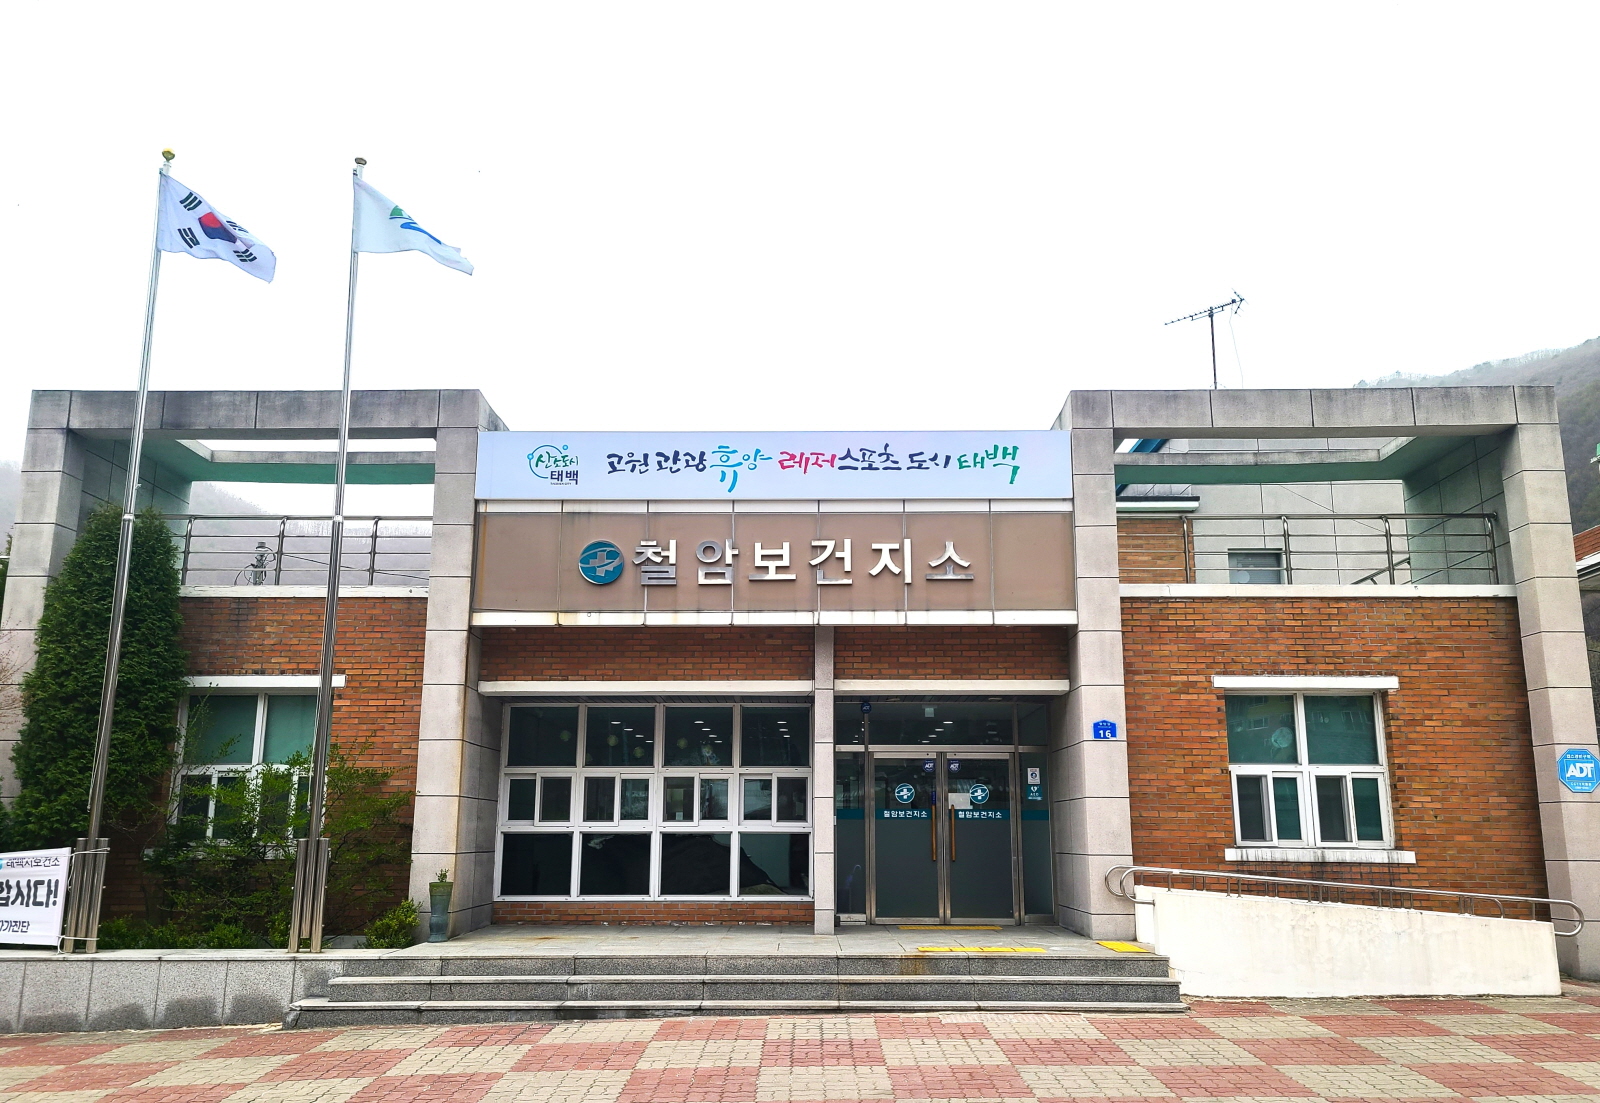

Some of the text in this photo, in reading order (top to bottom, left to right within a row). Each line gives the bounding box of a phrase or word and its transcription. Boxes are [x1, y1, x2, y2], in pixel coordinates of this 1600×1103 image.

[606, 452, 649, 475] 고원
[655, 450, 707, 474] 관광
[710, 445, 773, 493] 휴양
[906, 451, 951, 472] 도시
[957, 444, 1021, 485] 태백
[550, 469, 579, 486] 태백
[632, 538, 974, 586] 철암보건지소
[1098, 729, 1112, 738] 16
[1566, 763, 1594, 777] ADT
[883, 810, 928, 818] 철암보건지소
[958, 811, 1002, 819] 철암보건지소
